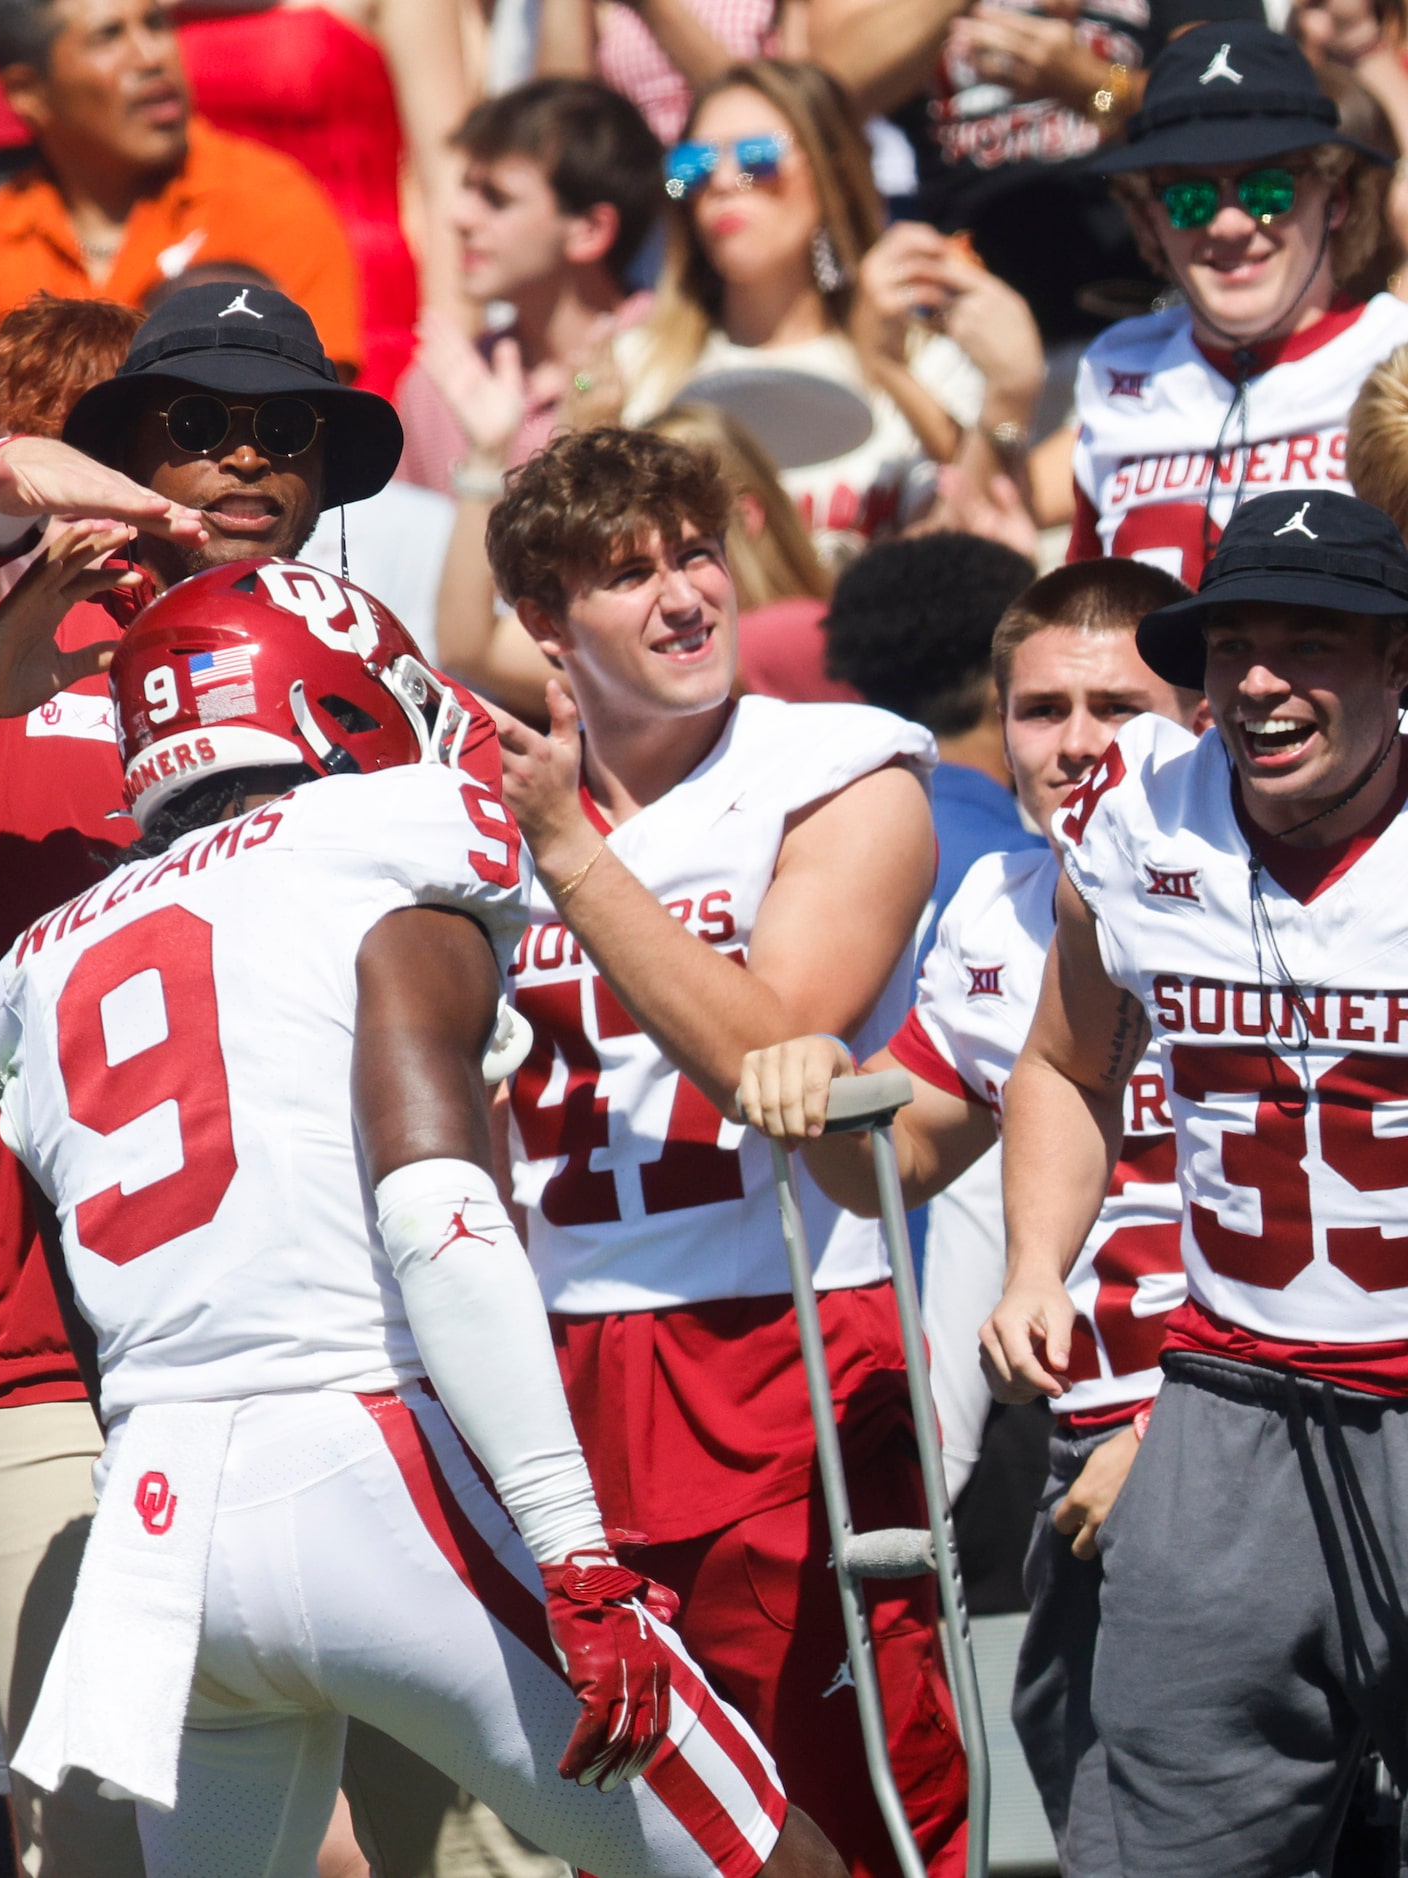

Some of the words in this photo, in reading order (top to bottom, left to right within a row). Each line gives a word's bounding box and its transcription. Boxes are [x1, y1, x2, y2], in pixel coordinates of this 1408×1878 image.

[256, 563, 380, 661] OU
[40, 701, 62, 726] OU
[144, 664, 180, 725] 9
[122, 737, 217, 812] OONERS
[458, 783, 521, 889] 9
[15, 790, 296, 968] WILLIAMS
[1145, 864, 1201, 902] XII
[966, 965, 1005, 996] XII
[56, 903, 239, 1266] 9
[510, 948, 745, 1227] 47
[134, 1470, 177, 1536] OU
